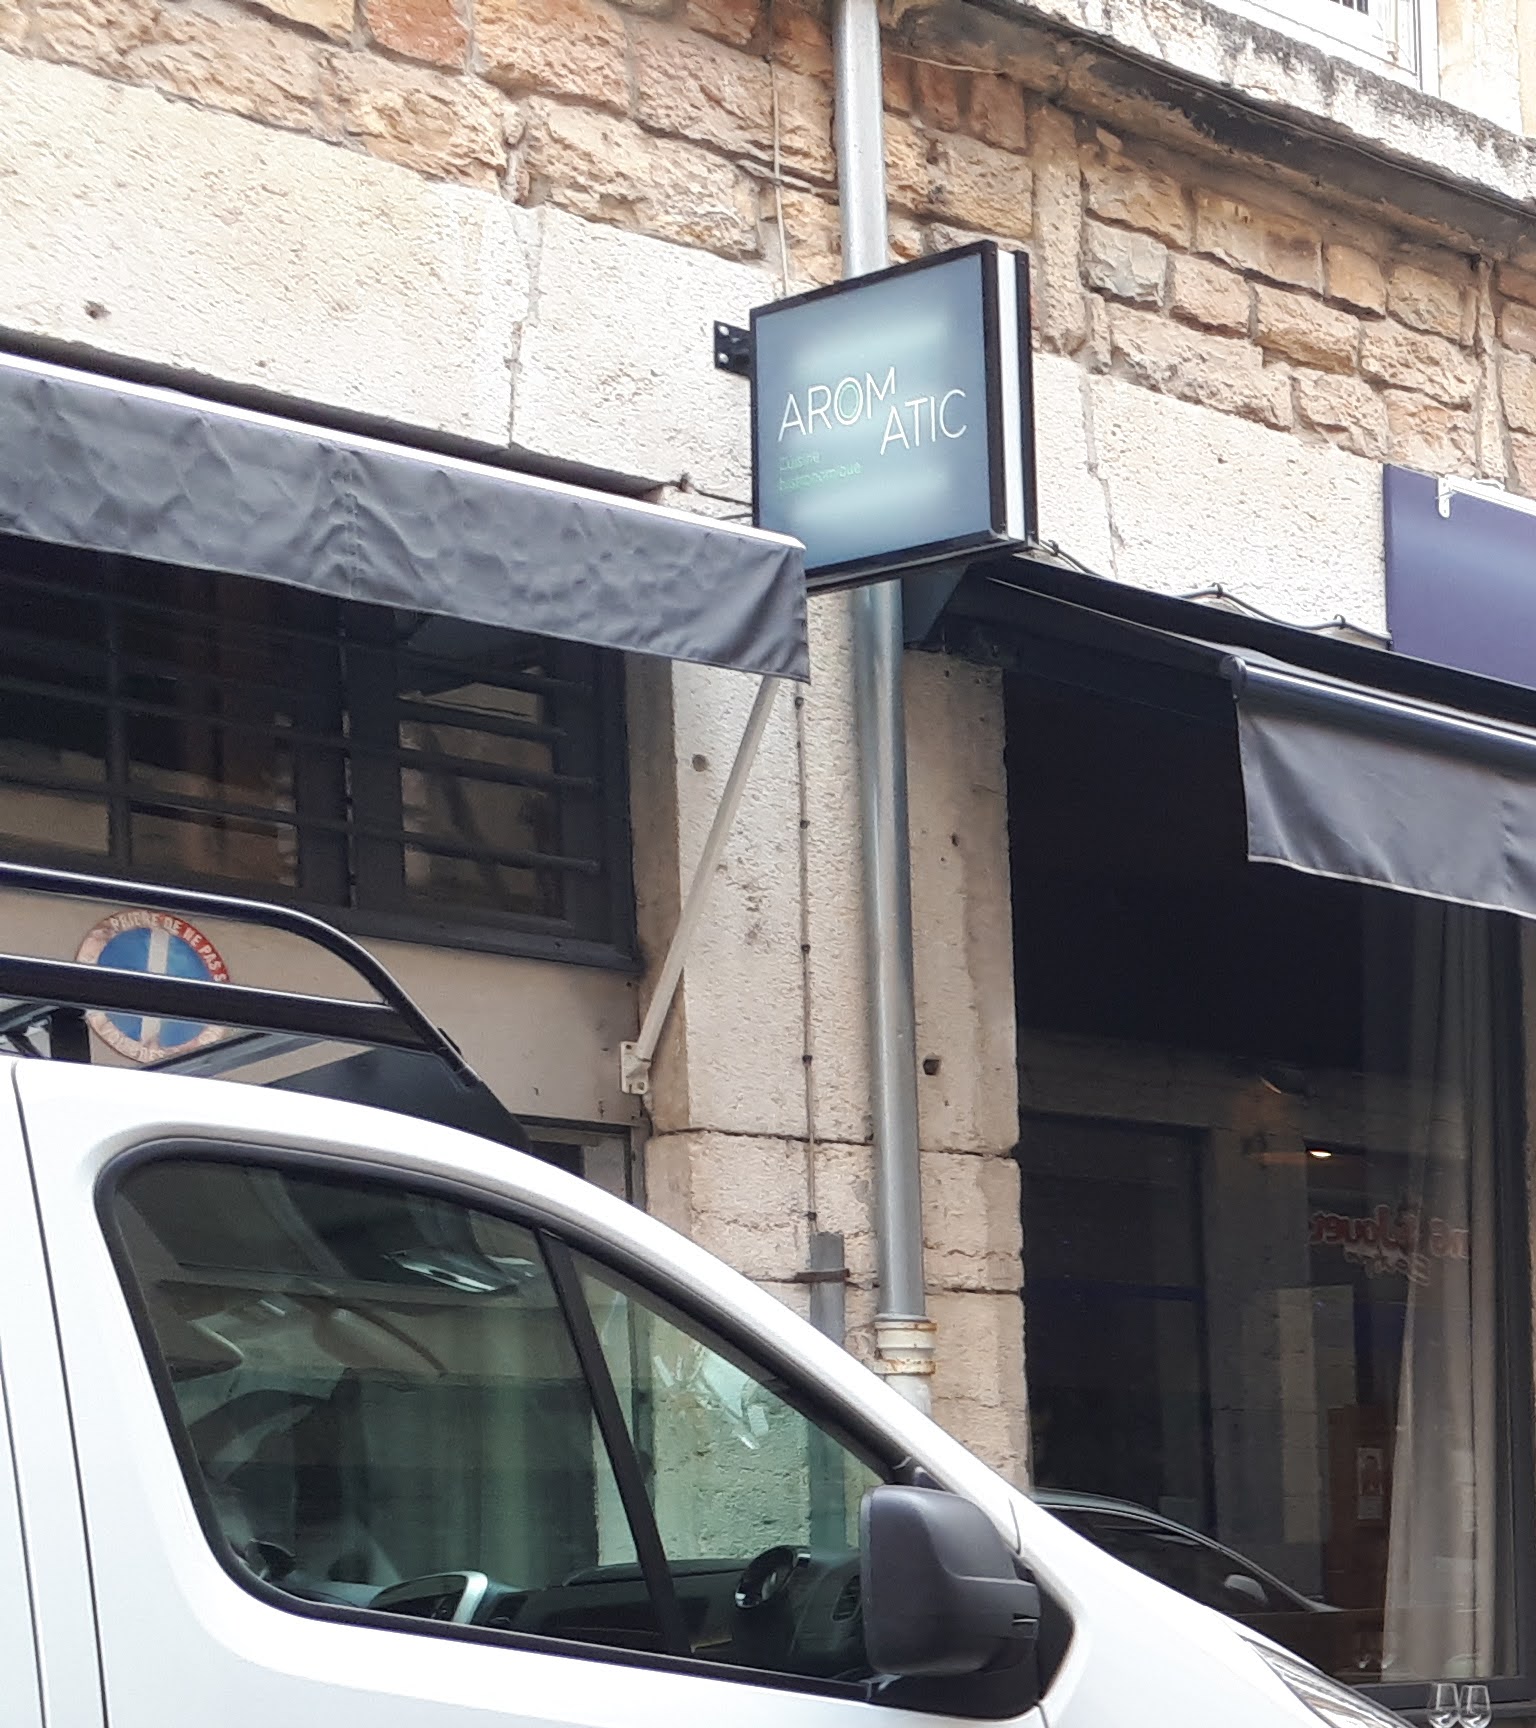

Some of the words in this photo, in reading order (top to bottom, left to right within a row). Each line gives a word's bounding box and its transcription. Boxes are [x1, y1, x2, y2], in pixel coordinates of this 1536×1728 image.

[778, 367, 896, 441] AROM
[880, 389, 967, 456] ATIC
[163, 916, 182, 936] DE
[183, 926, 203, 948] NE
[199, 944, 222, 971] PAS
